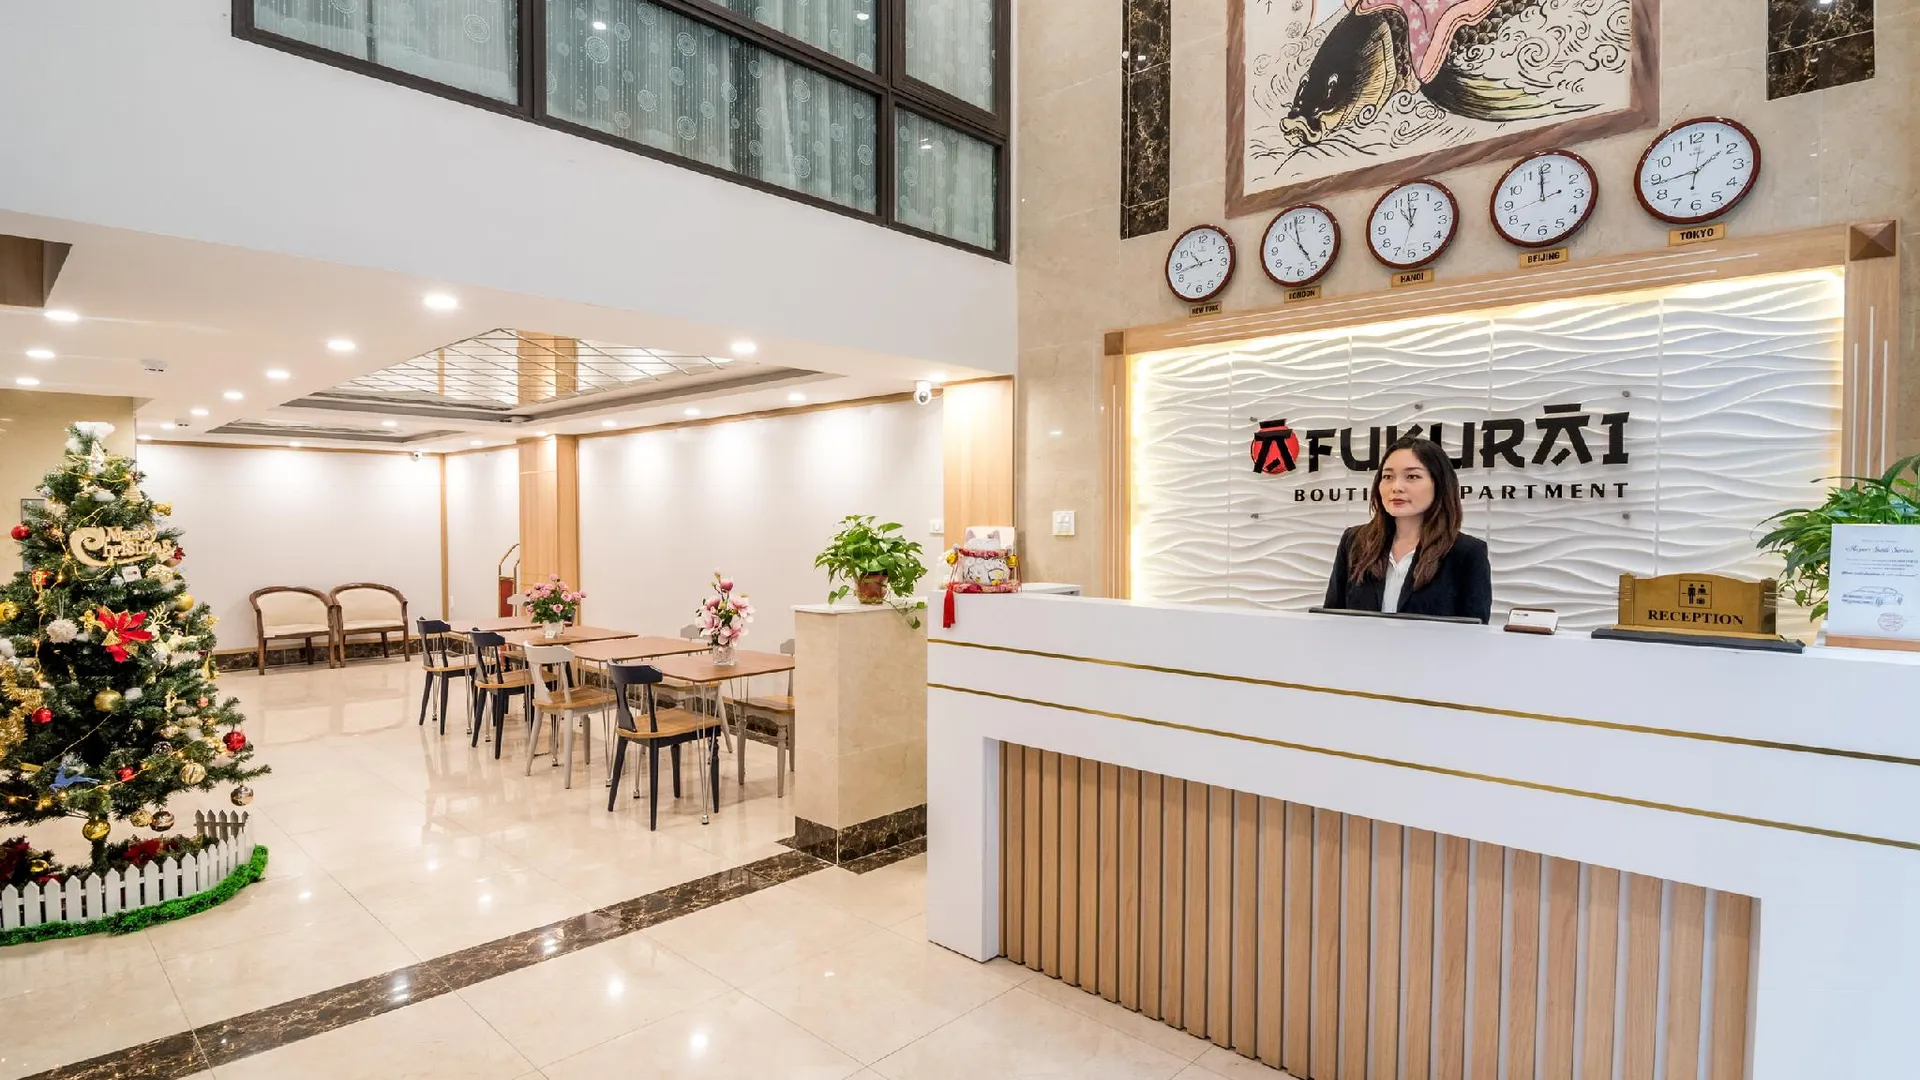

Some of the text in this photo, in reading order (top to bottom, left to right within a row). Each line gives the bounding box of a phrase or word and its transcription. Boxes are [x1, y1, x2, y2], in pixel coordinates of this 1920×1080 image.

[1688, 131, 1705, 145] 12
[1672, 140, 1683, 153] 11
[1726, 142, 1738, 155] 2
[1657, 156, 1671, 168] 10
[1732, 158, 1744, 170] 3
[1523, 171, 1533, 182] 11
[1568, 174, 1579, 185] 2
[1650, 173, 1662, 186] 9
[1726, 176, 1738, 187] 4
[1509, 185, 1523, 196] 10
[1573, 188, 1585, 199] 3
[1656, 189, 1668, 200] 8
[1710, 190, 1723, 203] 5
[1395, 198, 1403, 209] 11
[1433, 201, 1443, 211] 2
[1504, 200, 1514, 211] 9
[1670, 197, 1682, 209] 7
[1690, 200, 1702, 211] 6
[1568, 204, 1577, 215] 4
[1383, 210, 1395, 221] 10
[1437, 214, 1447, 225] 3
[1508, 214, 1519, 226] 8
[1284, 222, 1292, 232] 11
[1318, 223, 1327, 233] 2
[1521, 223, 1530, 234] 7
[1554, 218, 1565, 229] 5
[1378, 225, 1387, 236] 9
[1433, 230, 1442, 239] 4
[1537, 225, 1548, 236] 6
[1680, 228, 1714, 240] TOKYO
[1276, 233, 1285, 243] 10
[1323, 235, 1331, 245] 3
[1382, 238, 1391, 248] 8
[1271, 246, 1279, 256] 9
[1393, 247, 1401, 257] 7
[1422, 241, 1431, 252] 5
[1319, 250, 1327, 258] 4
[1527, 251, 1560, 263] BEIJING
[1275, 259, 1282, 268] 8
[1310, 261, 1318, 271] 5
[1285, 266, 1292, 275] 7
[1297, 268, 1305, 277] 6
[1400, 272, 1424, 283] HANOI
[1289, 290, 1315, 300] LONDON
[1192, 306, 1204, 315] NEW
[1294, 483, 1628, 502] BOUTI PARTMENT
[104, 524, 157, 542] Merry
[70, 526, 173, 567] Christmas
[1648, 609, 1744, 625] RECEPTION
